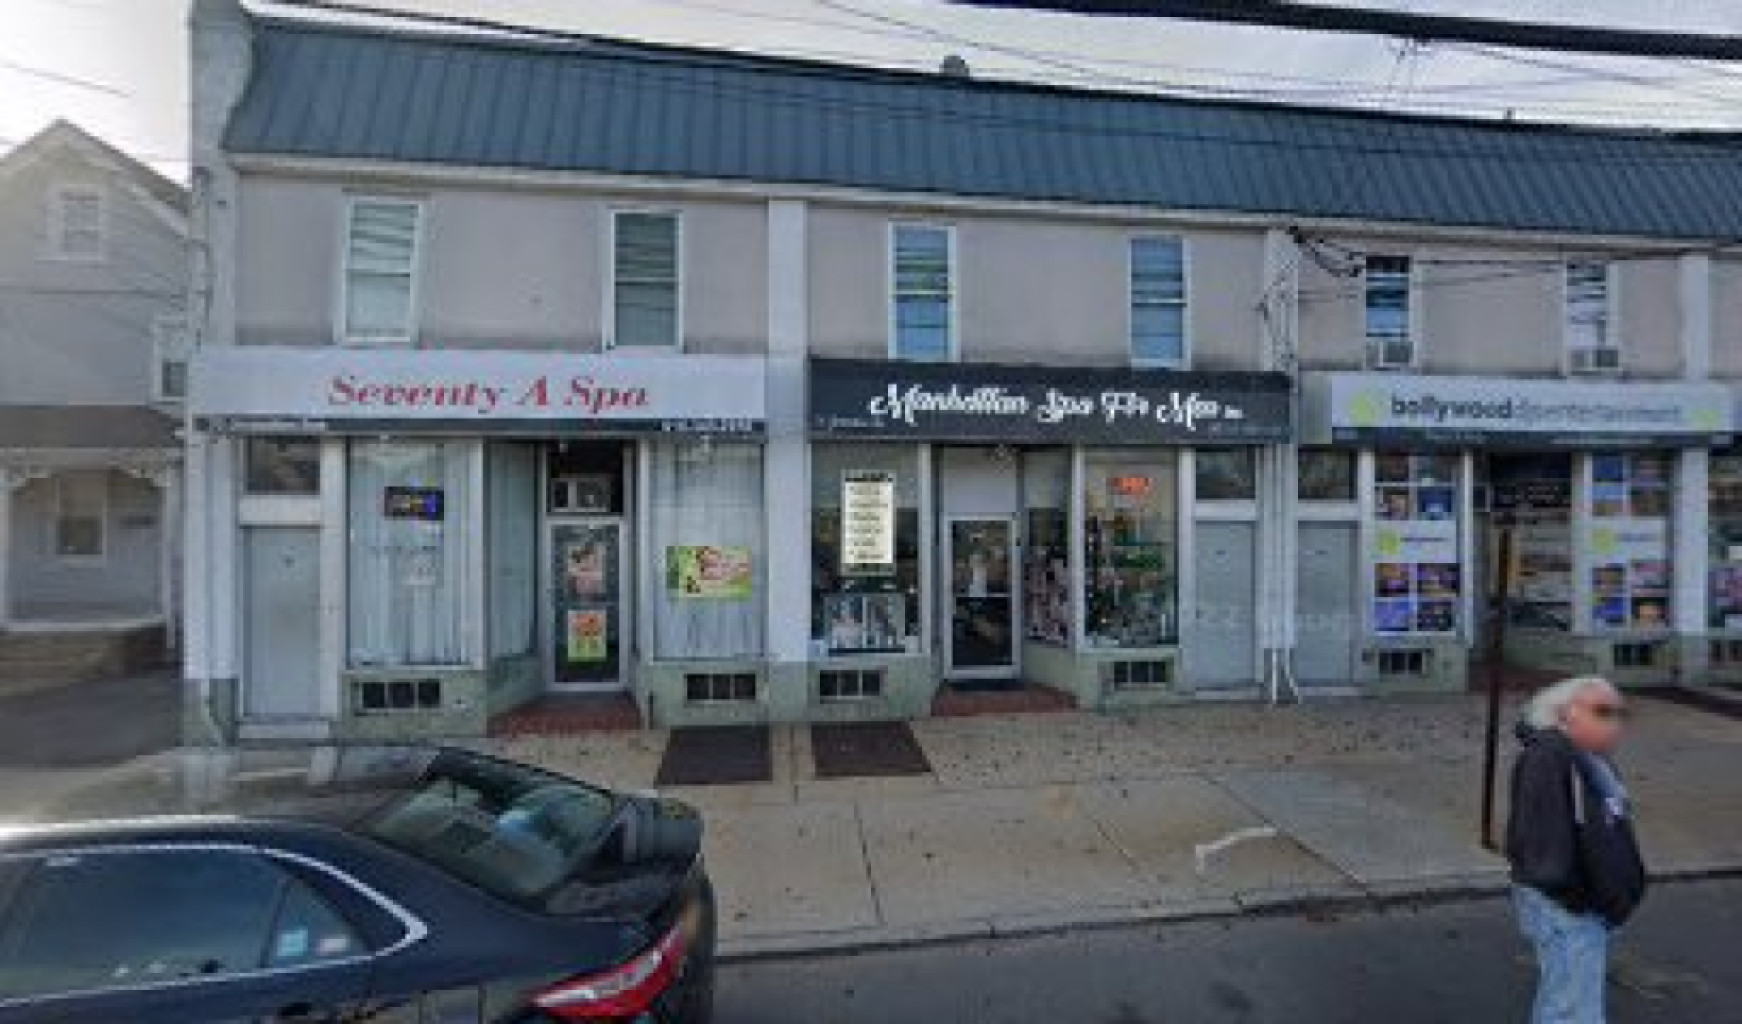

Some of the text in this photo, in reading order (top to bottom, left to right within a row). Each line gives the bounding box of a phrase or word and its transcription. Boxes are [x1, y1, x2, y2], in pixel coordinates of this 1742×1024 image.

[327, 374, 648, 413] Seventy A Spa
[869, 383, 1029, 426] Manhattan
[1037, 388, 1094, 423] Spa
[1156, 392, 1219, 431] Men
[1391, 395, 1512, 421] bollywood
